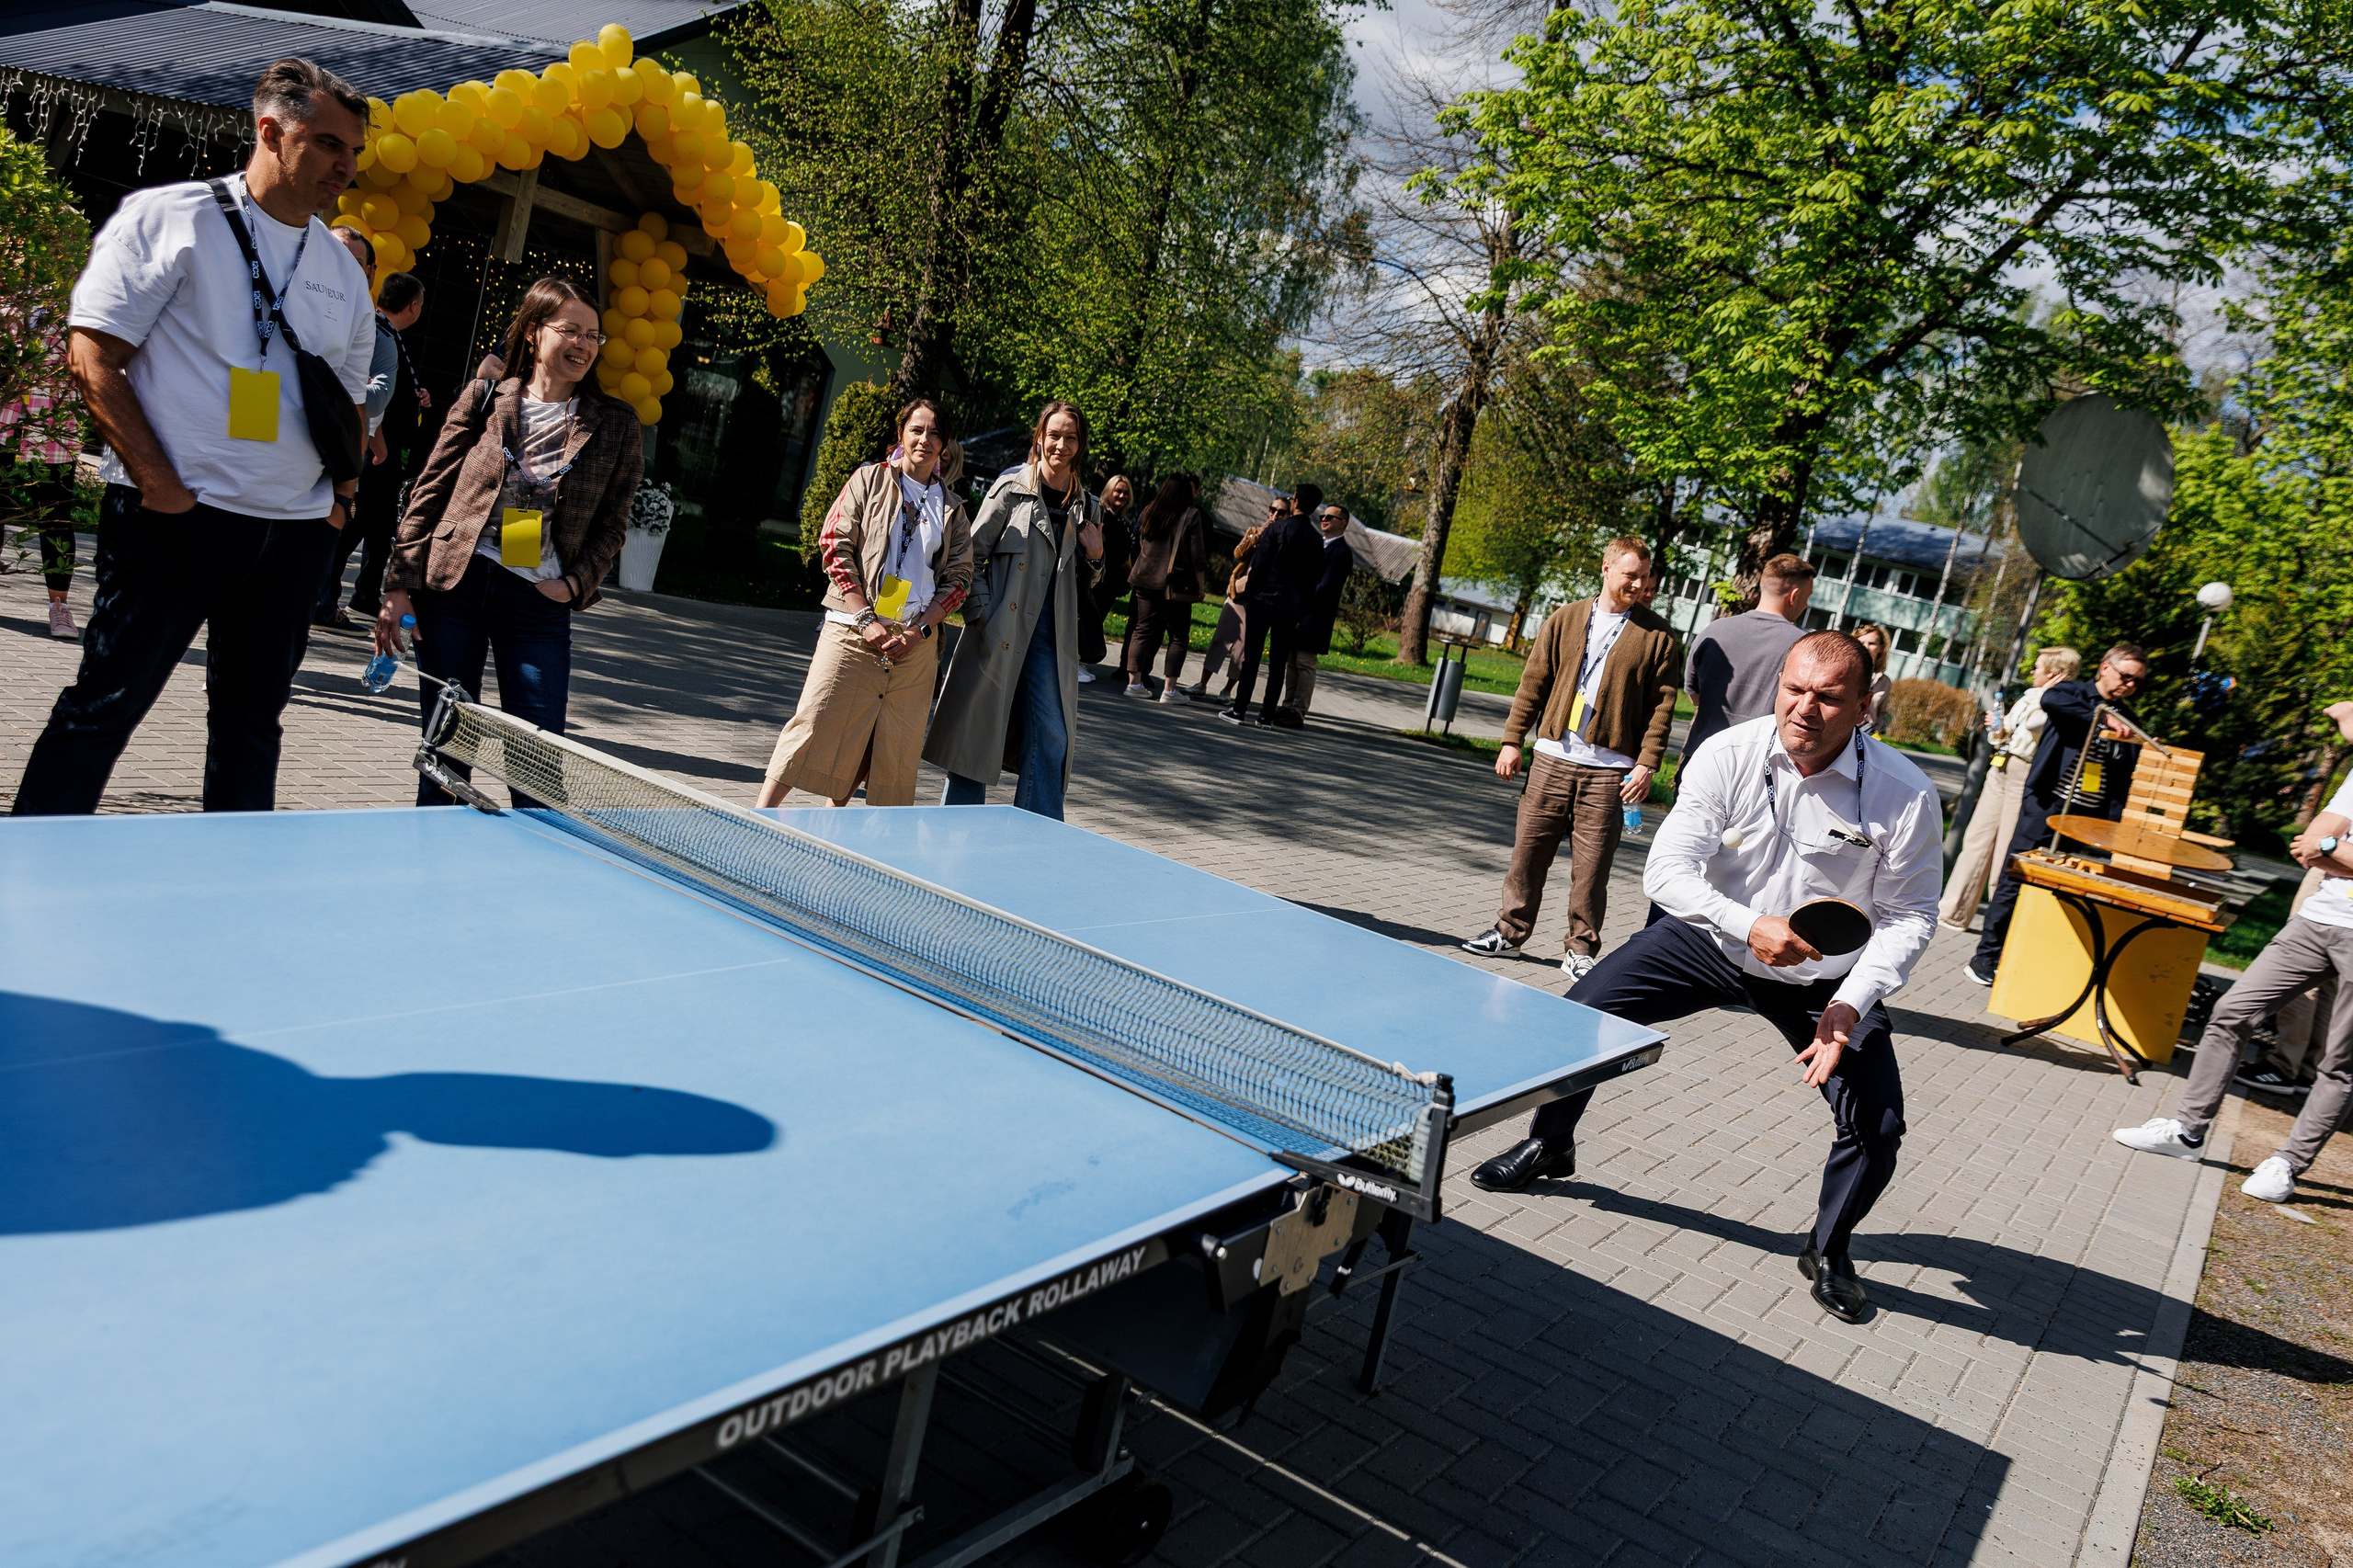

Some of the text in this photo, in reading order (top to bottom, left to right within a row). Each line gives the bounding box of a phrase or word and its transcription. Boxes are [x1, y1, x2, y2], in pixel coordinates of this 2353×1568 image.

[715, 1245, 1148, 1450] OUTDOOR PLAYBACK ROLLAWAY
